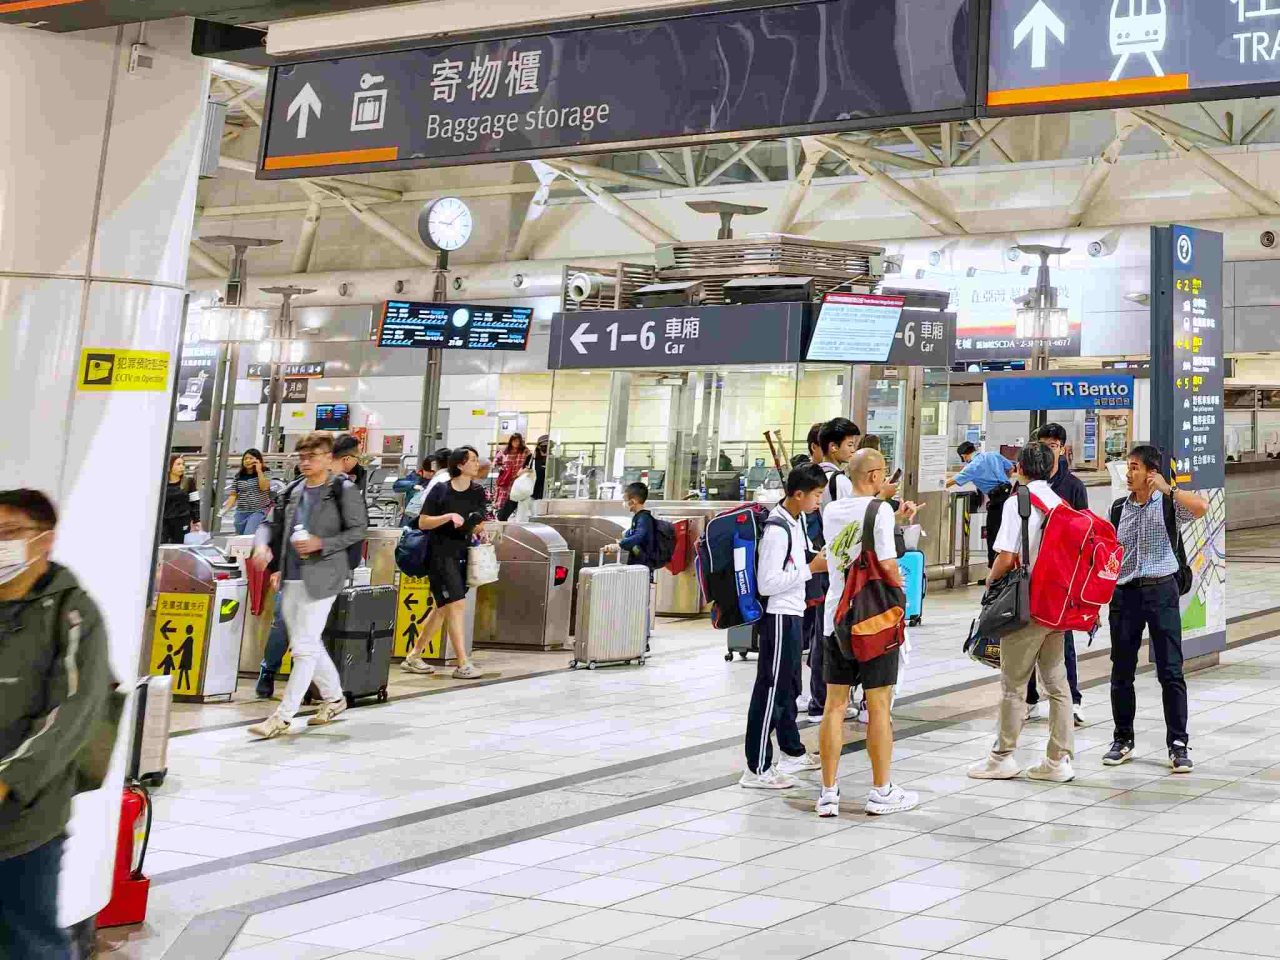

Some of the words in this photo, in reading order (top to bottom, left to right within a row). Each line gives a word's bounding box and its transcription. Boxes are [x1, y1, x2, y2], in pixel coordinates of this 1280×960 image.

[430, 49, 542, 103] 寄物櫃
[426, 112, 519, 143] Baggage
[524, 103, 610, 131] storage
[606, 320, 656, 351] 1-6
[664, 316, 700, 340] 車廂
[920, 320, 944, 340] 車廂
[664, 341, 686, 355] Car
[920, 340, 935, 352] Car
[1051, 381, 1075, 396] TR
[1078, 381, 1129, 396] Bento
[1184, 378, 1189, 389] 5
